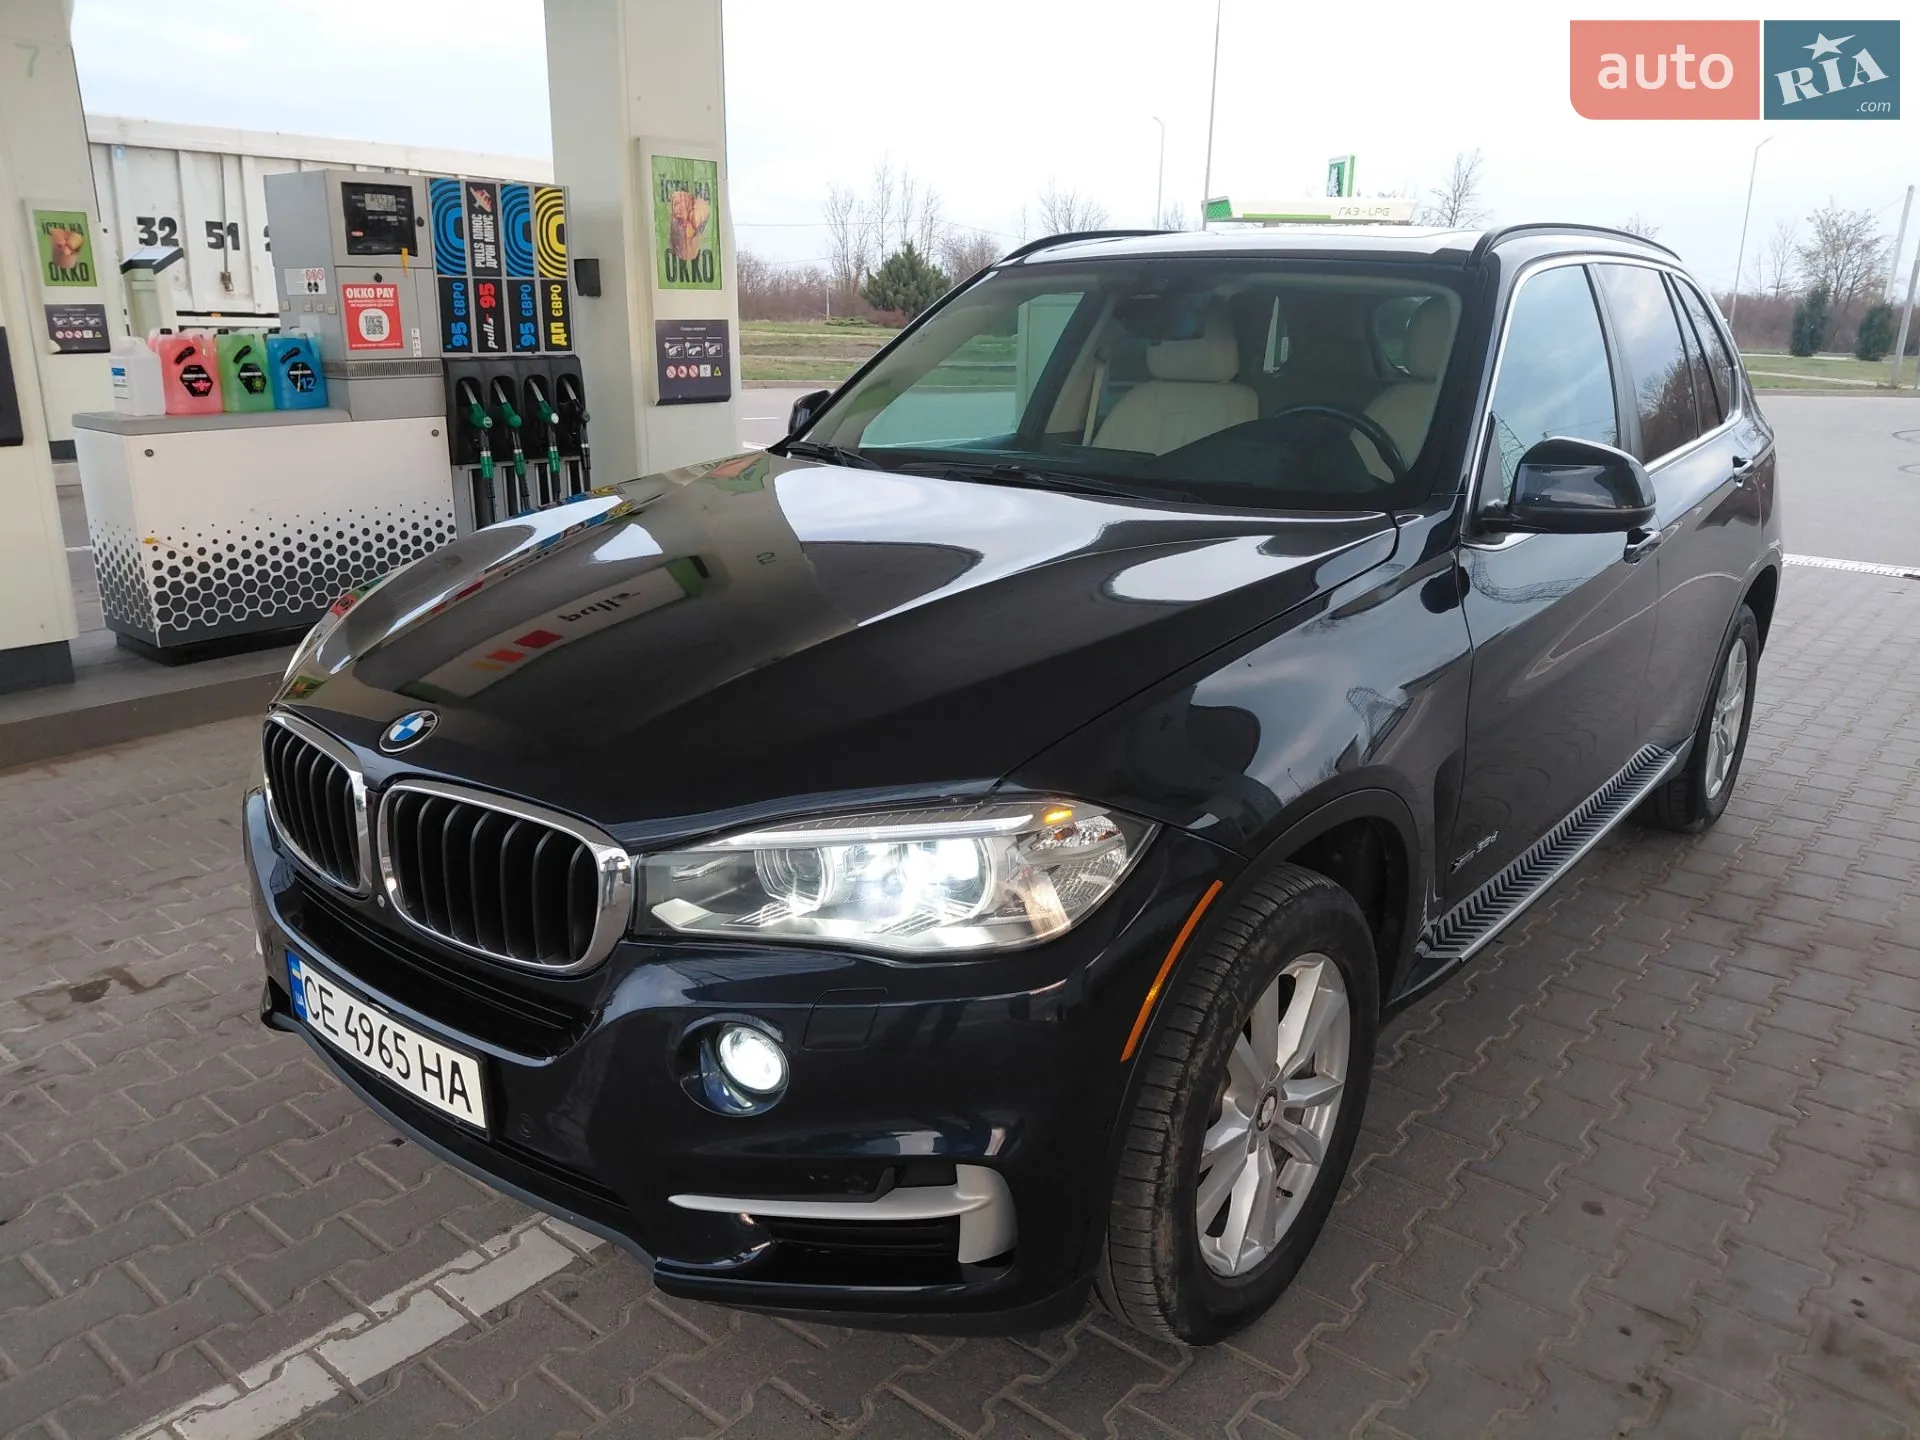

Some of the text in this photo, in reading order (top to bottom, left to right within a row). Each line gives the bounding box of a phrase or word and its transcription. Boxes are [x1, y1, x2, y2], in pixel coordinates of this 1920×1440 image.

[136, 216, 179, 247] 32
[205, 220, 240, 251] 51
[471, 213, 486, 268] PULLS ПЛЮС
[483, 214, 498, 269] ДРОН МІНУС
[346, 287, 394, 299] OKKO PAY
[451, 282, 468, 347] 95 ЄВРО
[478, 282, 496, 308] 95
[520, 284, 536, 347] 95 ЄВРО
[550, 284, 568, 347] ДП ЄВРО
[304, 975, 473, 1114] CE 4965 HA
